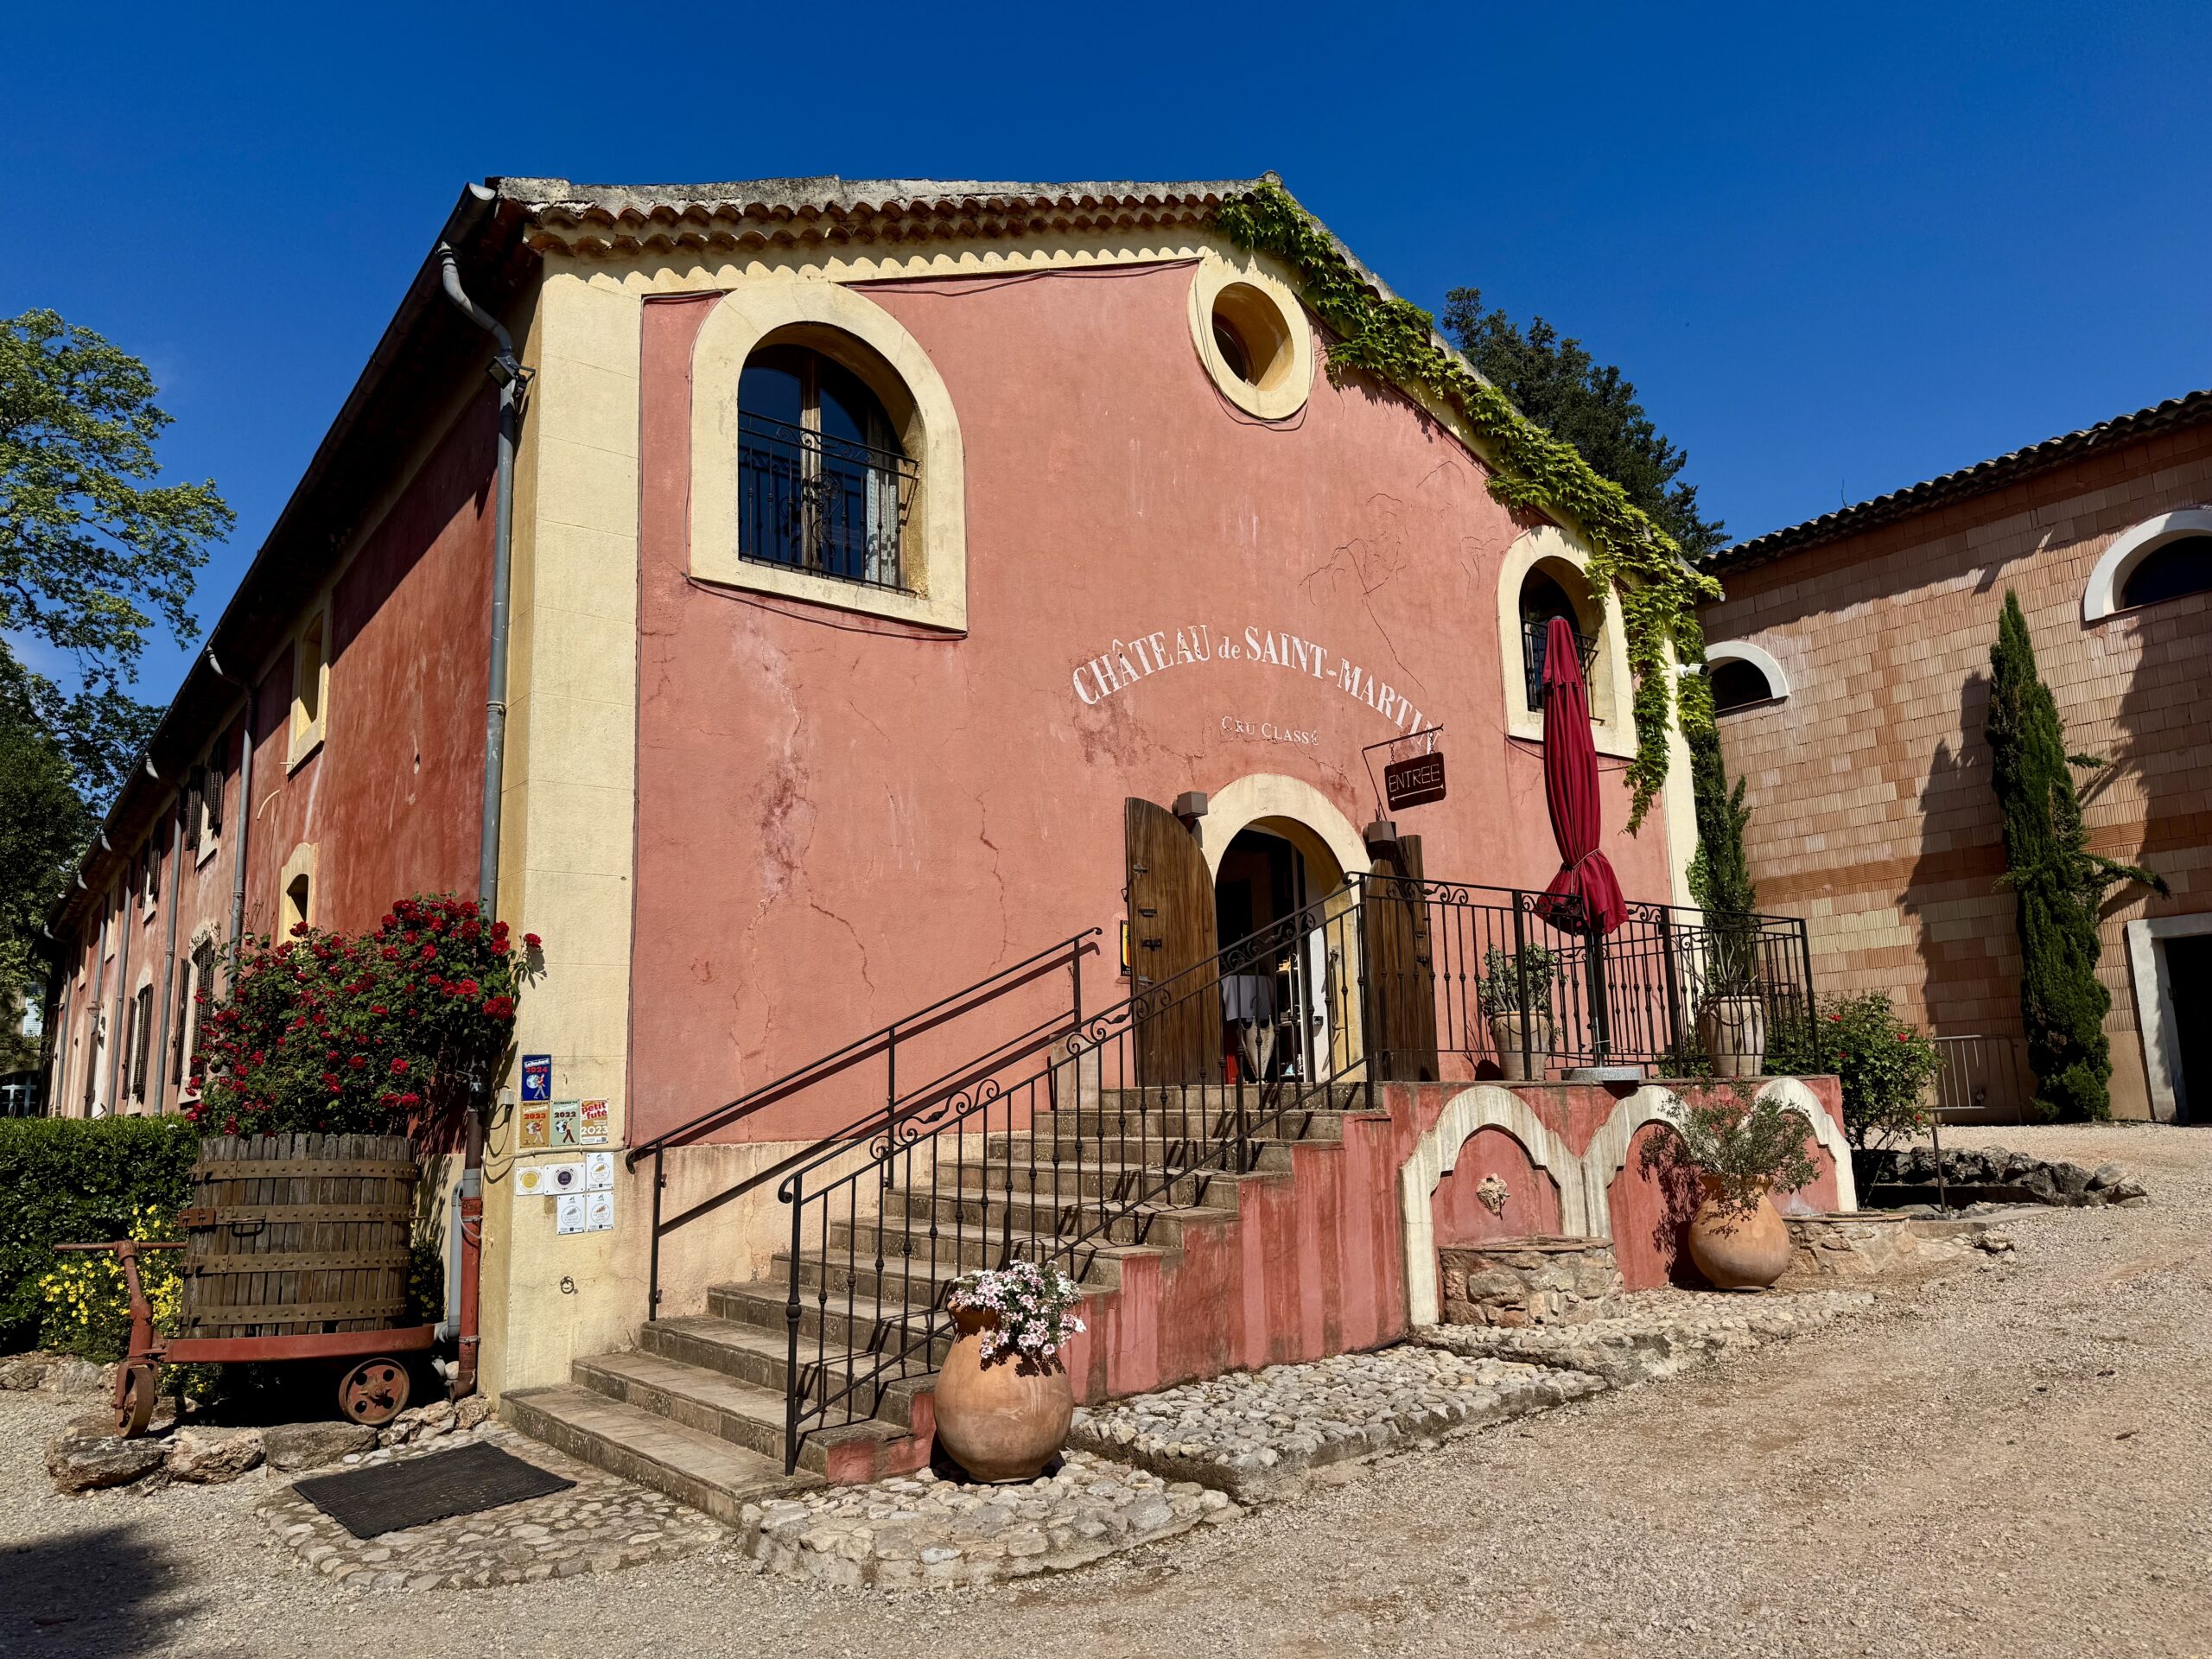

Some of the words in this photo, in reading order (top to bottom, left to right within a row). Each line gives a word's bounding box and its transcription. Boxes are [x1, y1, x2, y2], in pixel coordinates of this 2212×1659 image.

[1072, 625, 1211, 705] CHÂTEAU
[1218, 636, 1242, 659] de
[1388, 763, 1440, 793] ENTREE
[581, 1102, 607, 1115] petit
[587, 1109, 607, 1120] futé
[581, 1125, 608, 1135] 2023
